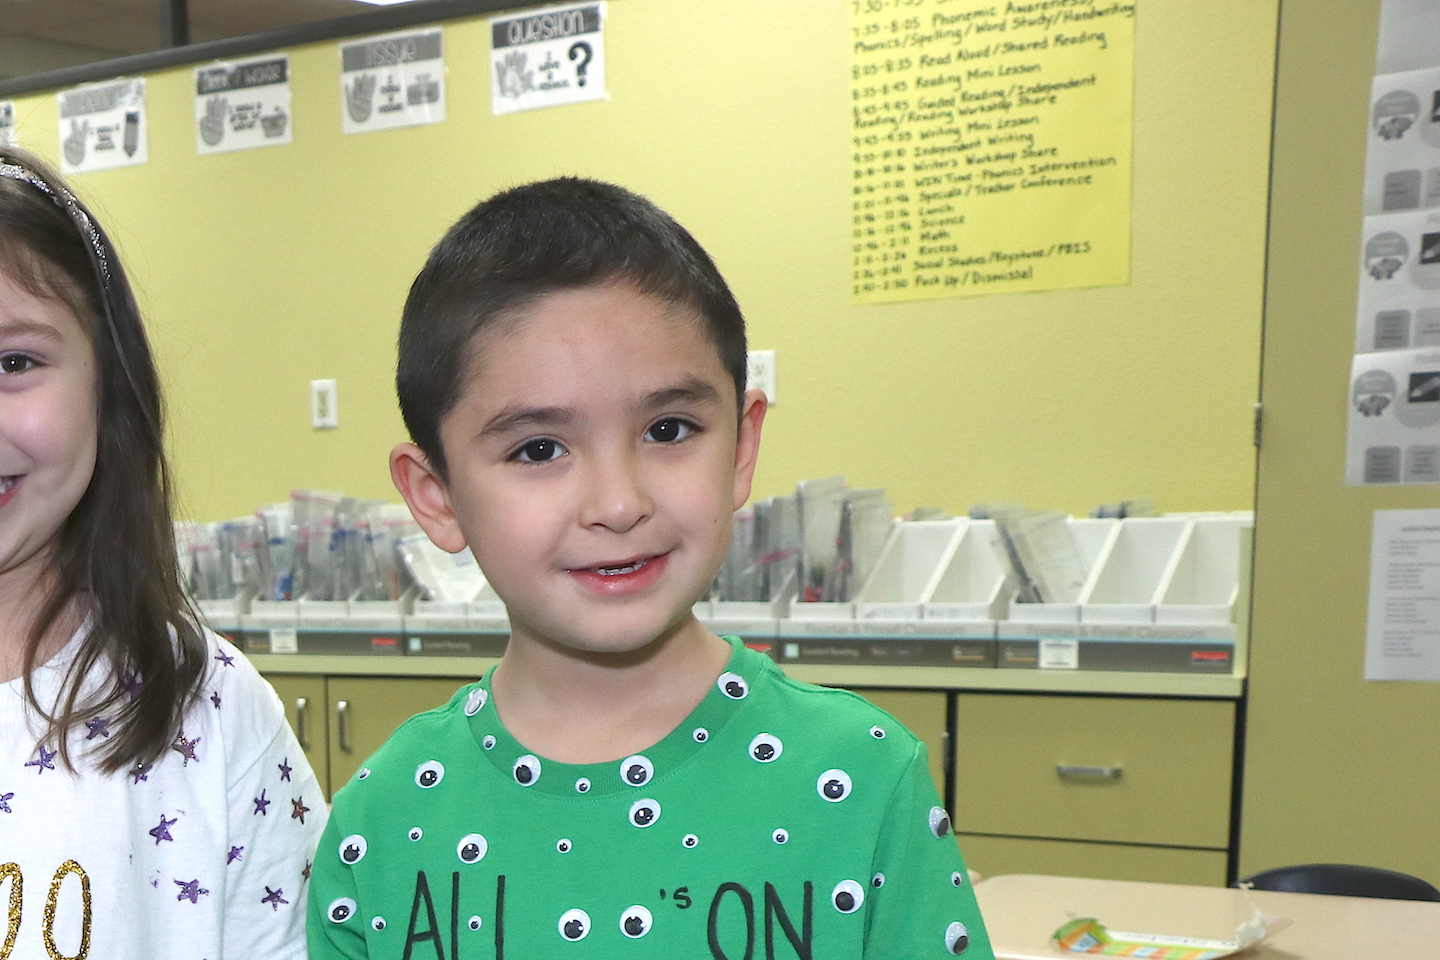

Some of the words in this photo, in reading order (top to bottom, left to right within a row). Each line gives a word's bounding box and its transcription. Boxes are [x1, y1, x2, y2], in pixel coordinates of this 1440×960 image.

[931, 7, 997, 28] Phonemic
[919, 53, 952, 68] Read
[1054, 31, 1108, 50] Reading
[916, 75, 962, 92] Reading
[967, 68, 995, 81] Mini
[998, 64, 1042, 76] Lesson
[1017, 94, 1057, 107] Share
[997, 115, 1040, 129] Lesson
[1021, 147, 1059, 160] Share
[1030, 156, 1118, 176] Intervention
[919, 228, 952, 242] Math
